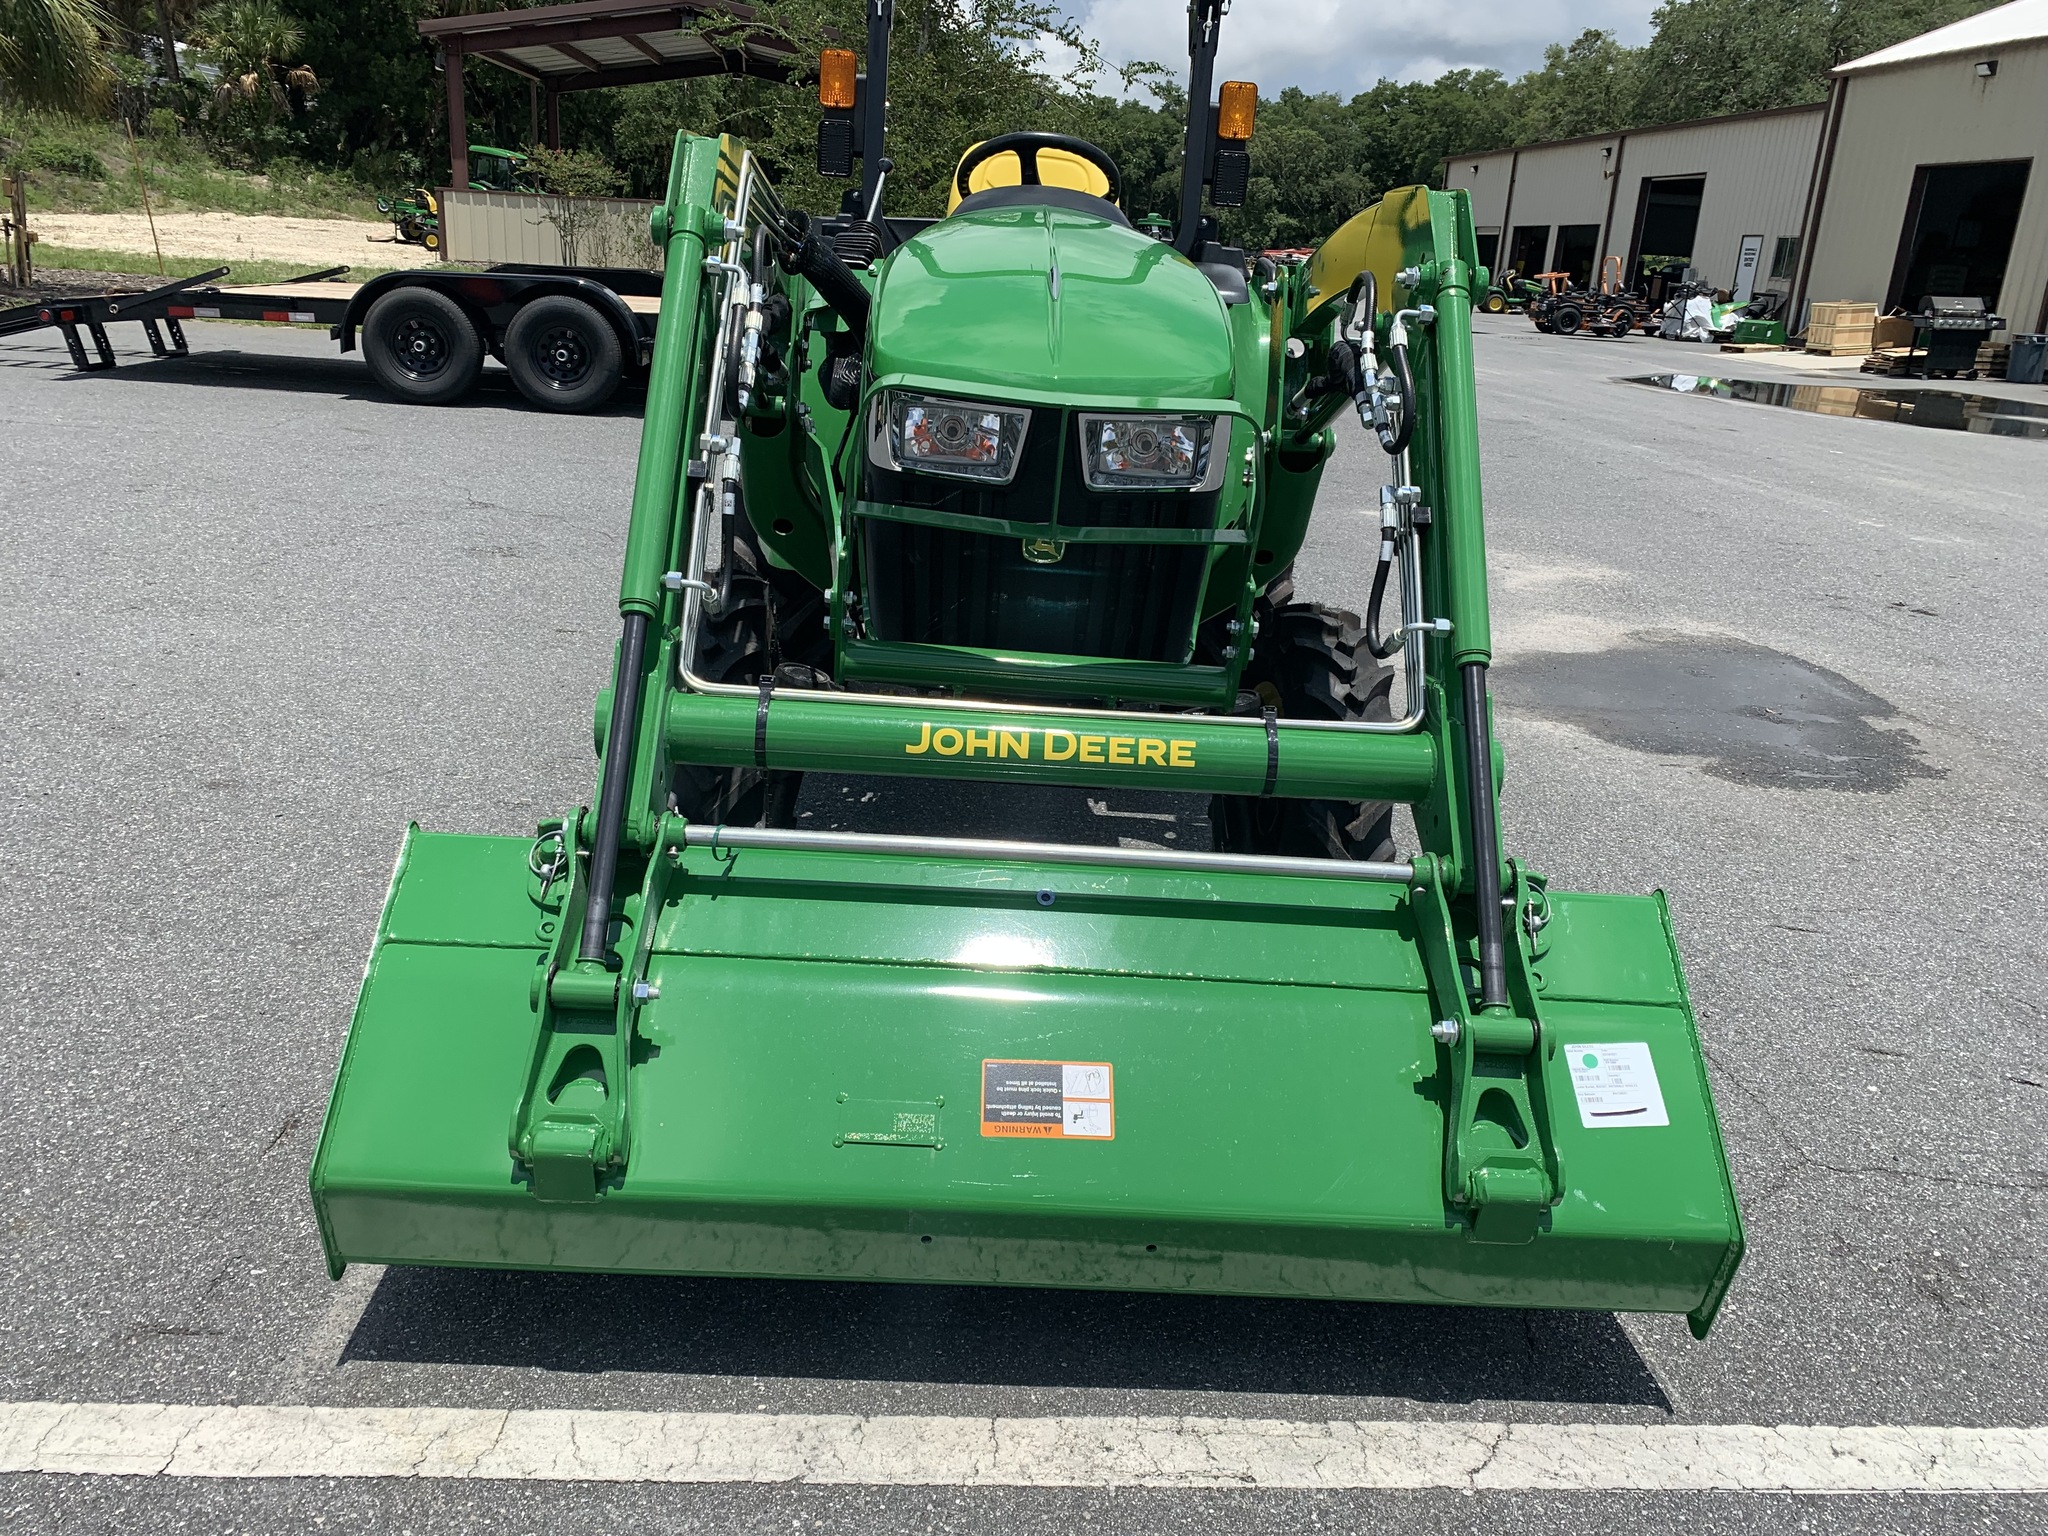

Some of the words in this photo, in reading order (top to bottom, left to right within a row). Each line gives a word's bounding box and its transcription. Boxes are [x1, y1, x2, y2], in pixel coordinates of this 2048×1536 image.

[905, 722, 1030, 759] JOHN
[1043, 729, 1197, 768] DEERE
[994, 1125, 1041, 1134] WARNING
